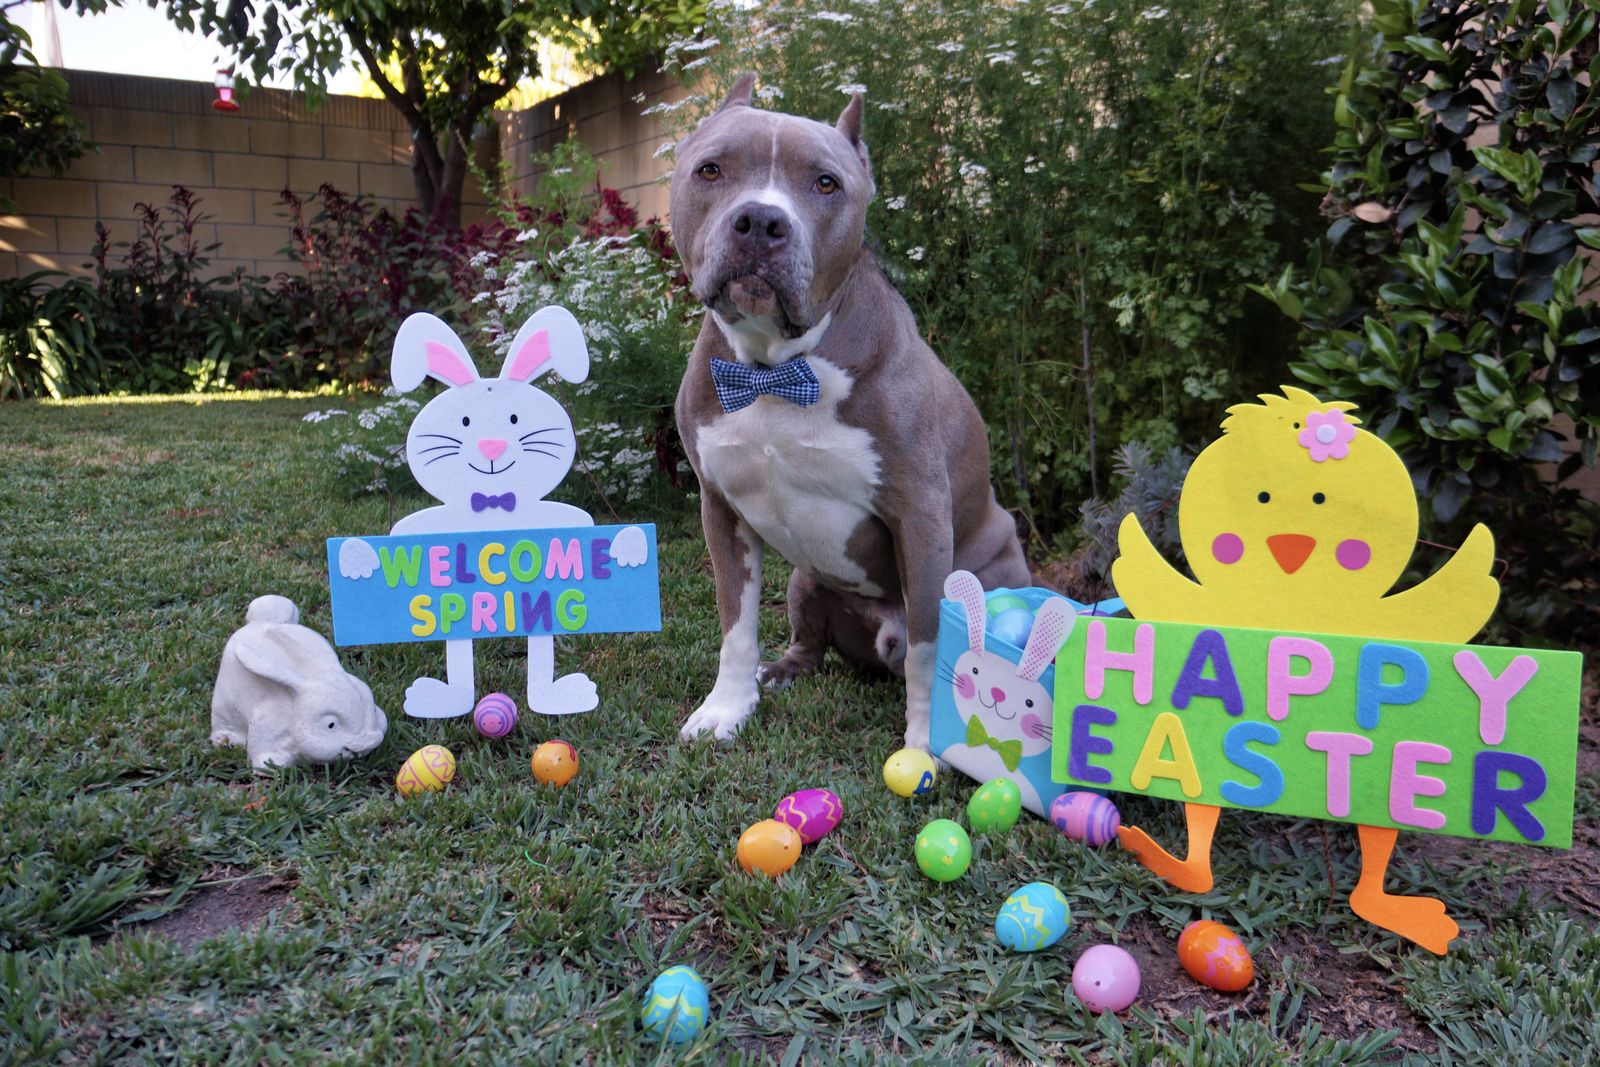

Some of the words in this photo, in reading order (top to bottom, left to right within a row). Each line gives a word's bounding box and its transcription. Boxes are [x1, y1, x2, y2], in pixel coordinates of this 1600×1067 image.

[378, 537, 612, 588] WELCOME
[410, 588, 588, 637] SPRING
[1084, 620, 1538, 745] HAPPY
[1067, 704, 1547, 842] EASTER
